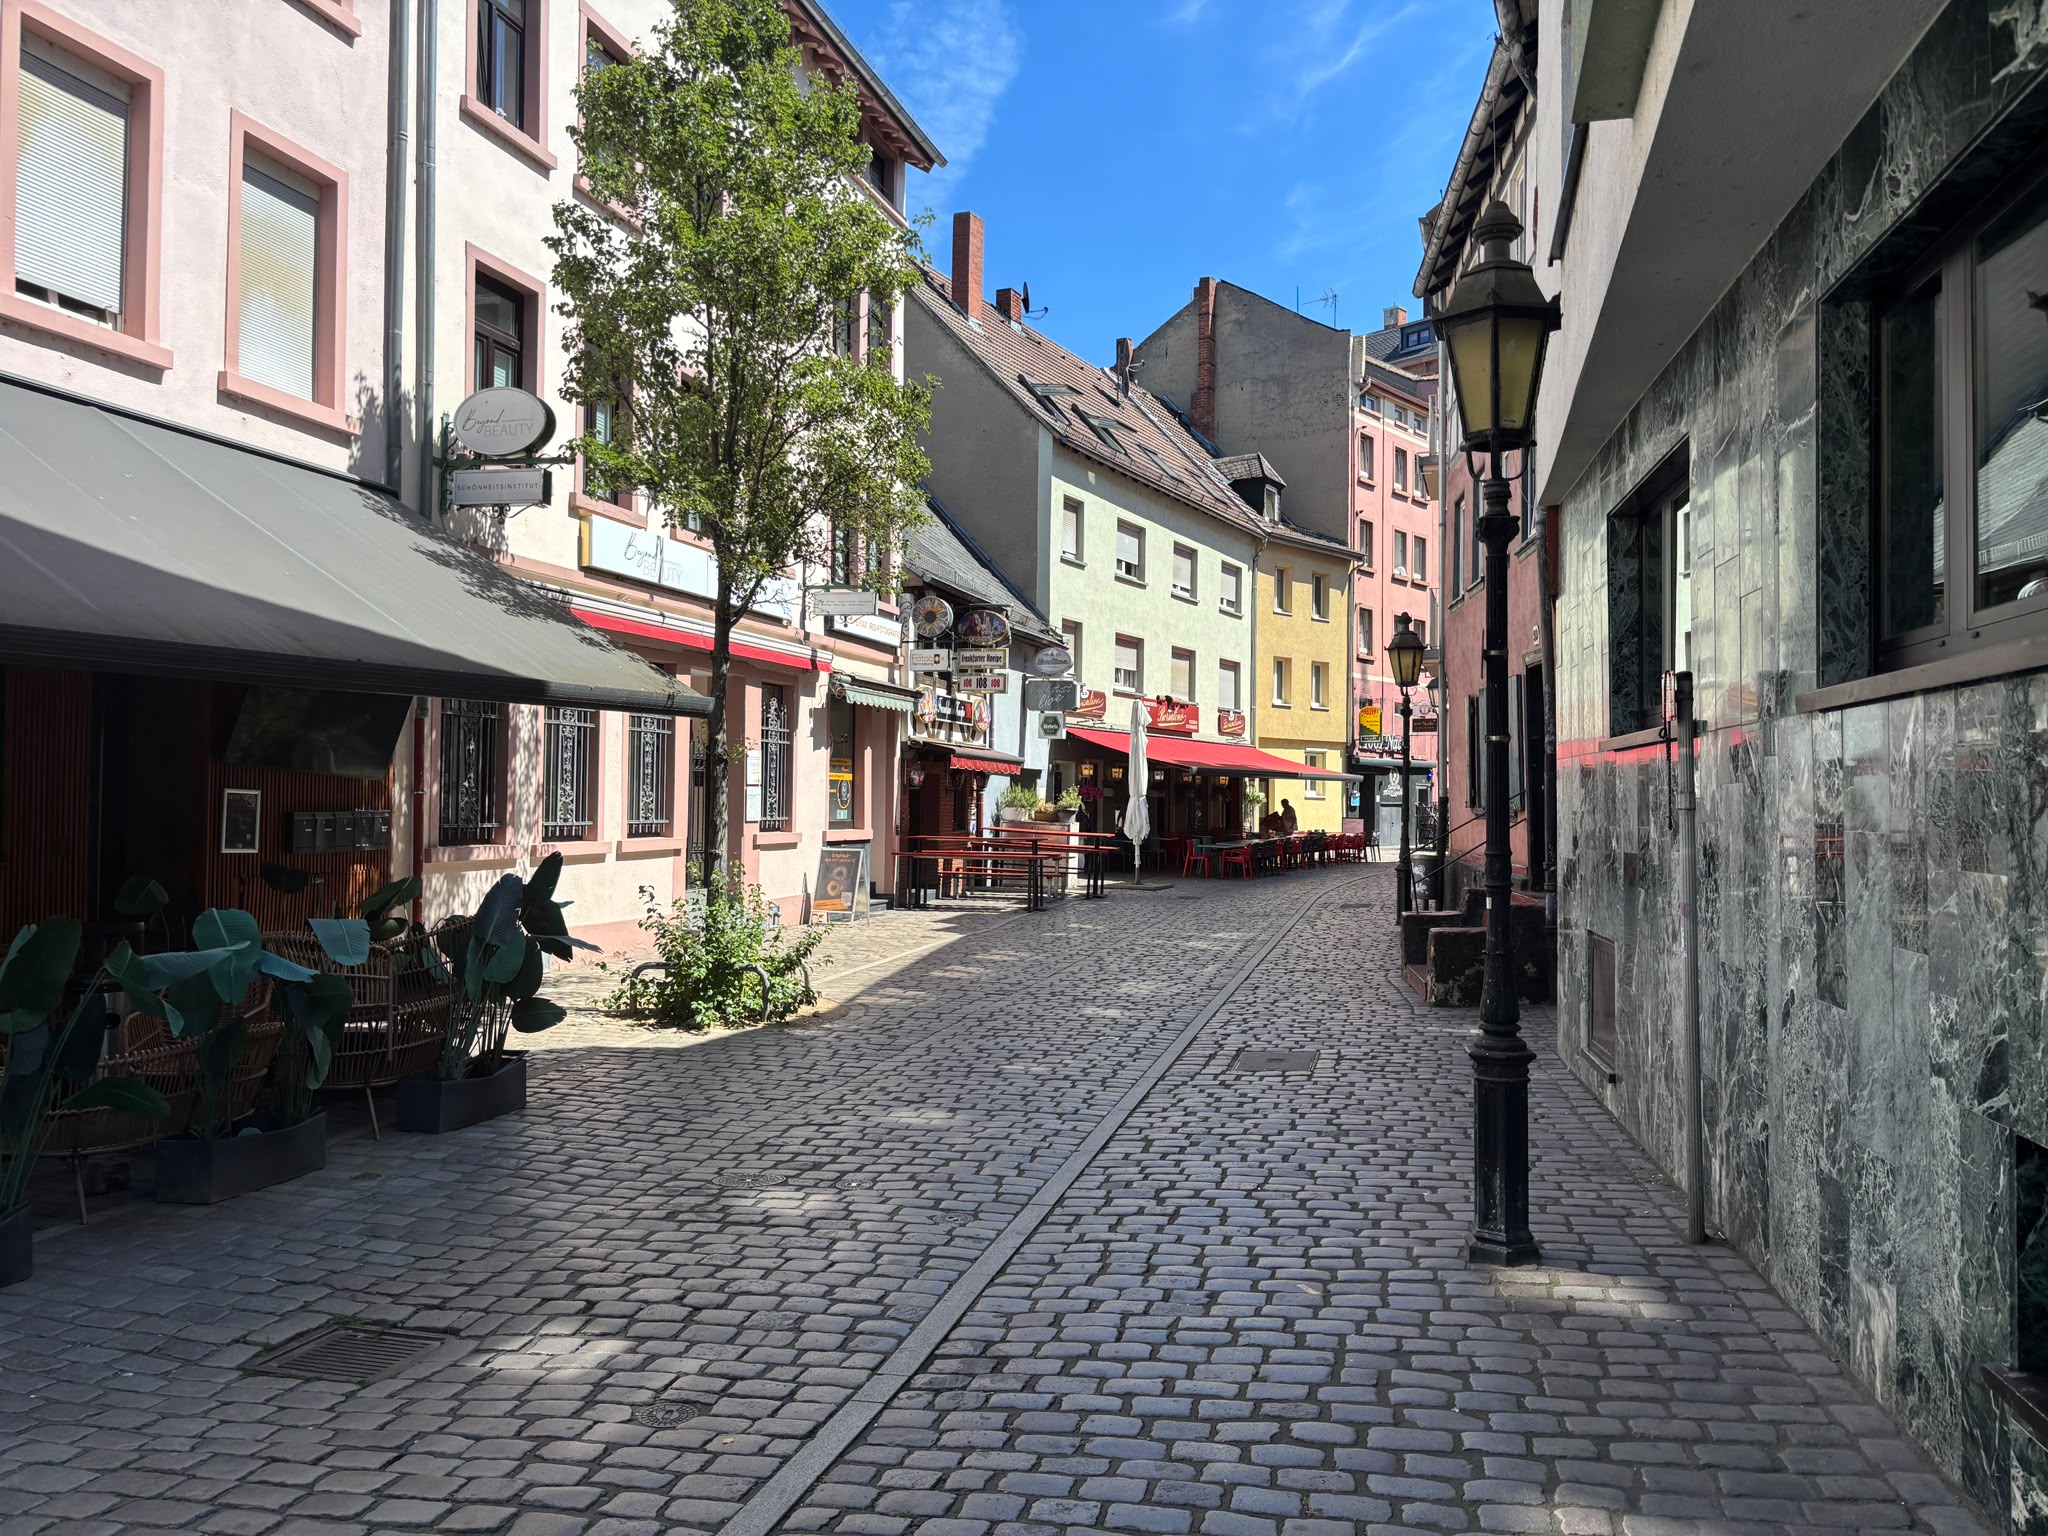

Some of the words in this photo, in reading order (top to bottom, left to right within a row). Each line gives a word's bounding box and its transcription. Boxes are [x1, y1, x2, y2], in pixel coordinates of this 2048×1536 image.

[462, 408, 504, 432] Beyond
[483, 423, 534, 438] BEAUTY
[457, 482, 540, 492] SCHÖNHEITSINSTITUT
[961, 654, 986, 663] Frankfurter
[987, 654, 1002, 663] Kneipe
[963, 678, 973, 688] 108
[976, 677, 988, 689] 108
[991, 678, 1001, 688] 108
